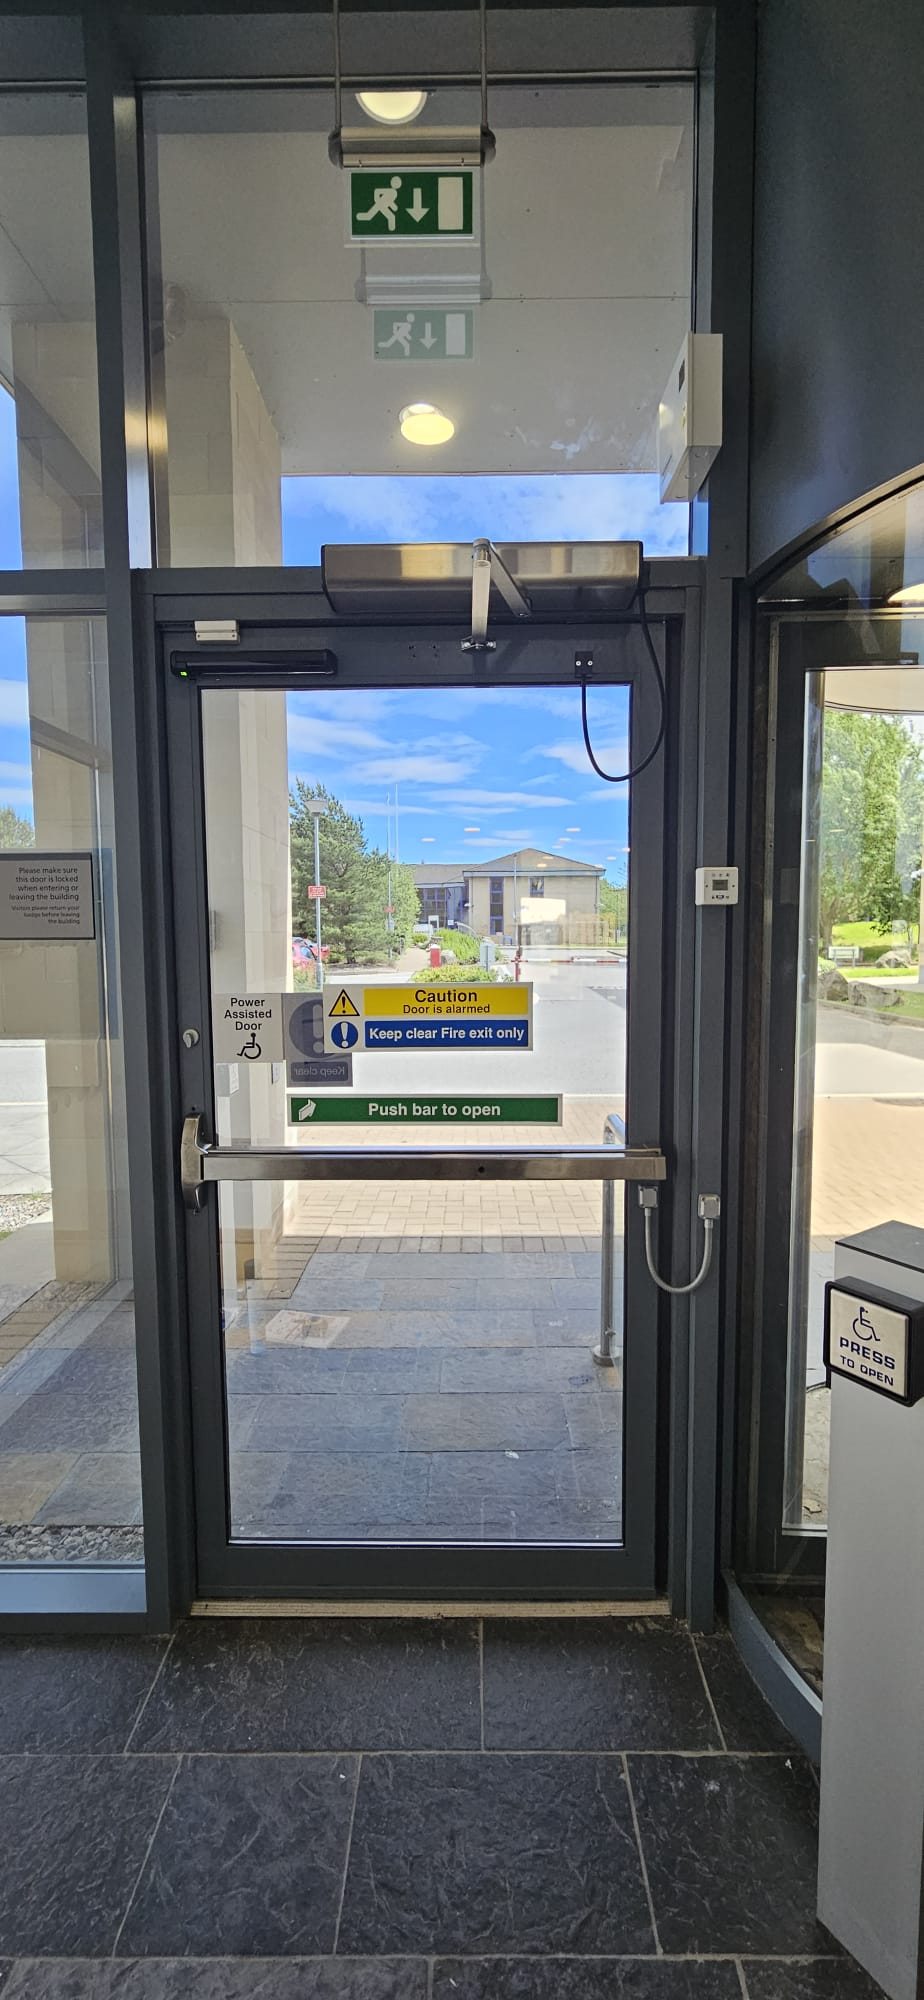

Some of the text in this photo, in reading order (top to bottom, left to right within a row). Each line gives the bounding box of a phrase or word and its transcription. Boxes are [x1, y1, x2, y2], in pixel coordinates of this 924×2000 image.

[9, 894, 35, 902] leaving
[50, 894, 79, 902] building
[414, 989, 478, 1003] Caution
[230, 998, 266, 1007] Power
[224, 1009, 272, 1019] Assisted
[403, 1004, 490, 1014] Door is alarmed
[235, 1021, 263, 1031] Door
[369, 1027, 525, 1041] Keep clear Fire exit only
[368, 1103, 501, 1119] Push bar to open
[839, 1336, 896, 1370] PRESS
[840, 1355, 894, 1386] TO OPEN
